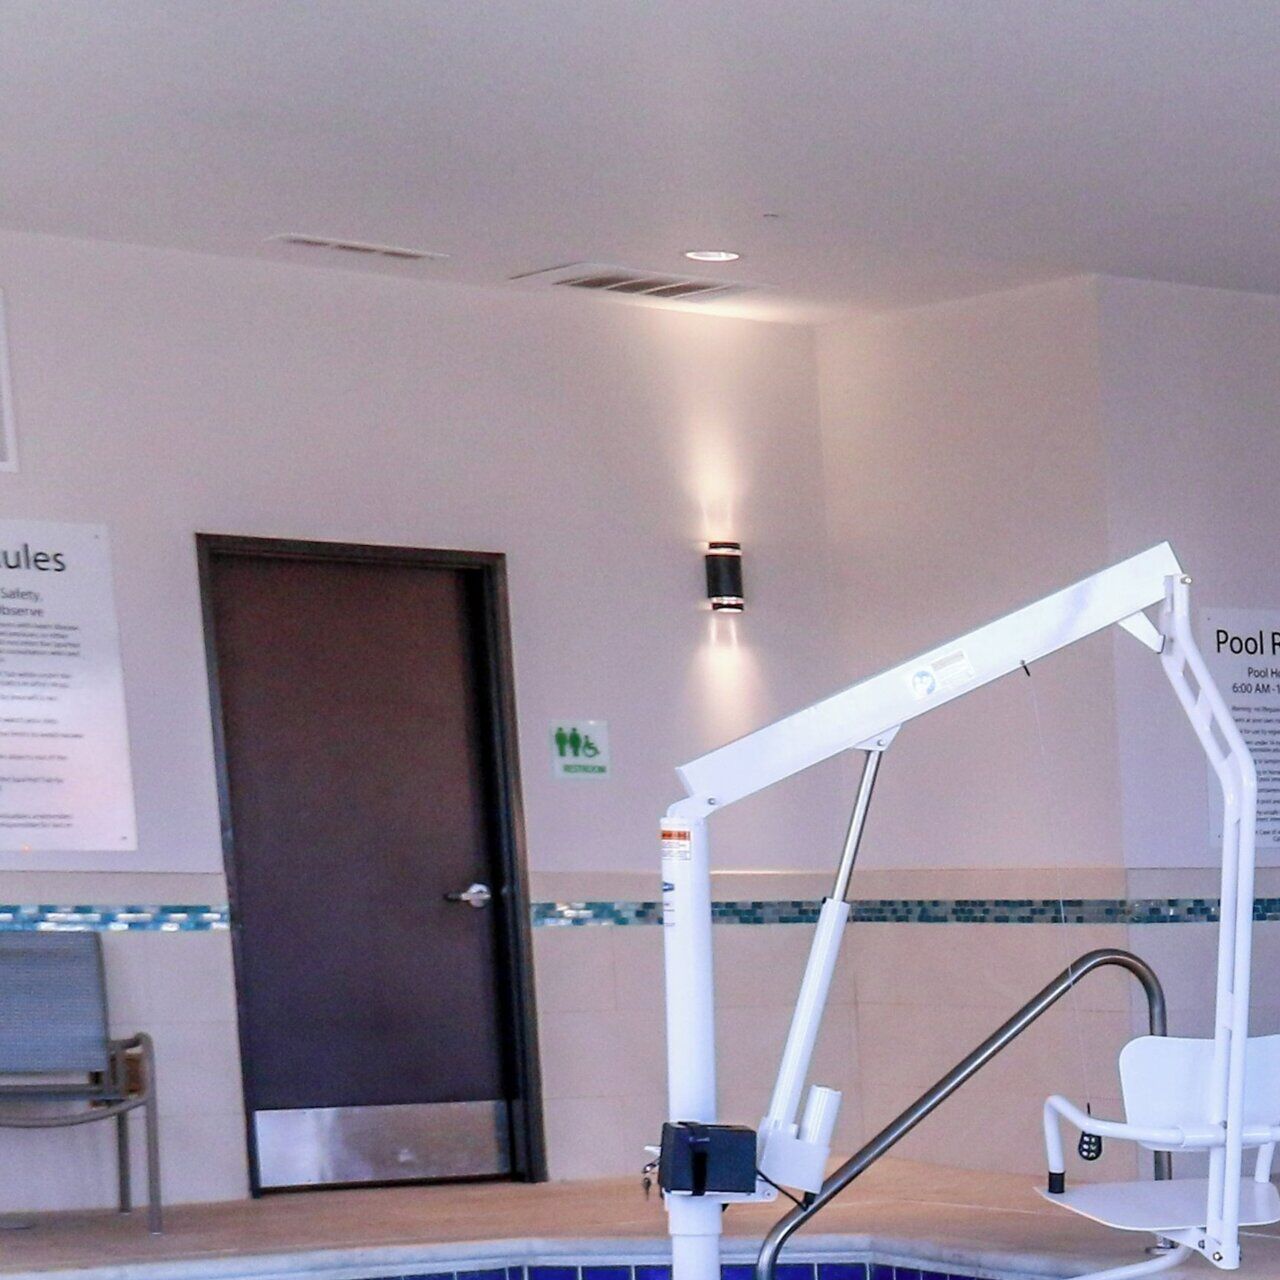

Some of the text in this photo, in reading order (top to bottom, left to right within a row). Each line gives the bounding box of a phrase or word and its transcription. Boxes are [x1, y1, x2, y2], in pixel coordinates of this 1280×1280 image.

[0, 543, 66, 571] ules
[0, 606, 44, 617] bserve
[1216, 629, 1264, 655] Pool
[1248, 667, 1269, 679] Pool
[1232, 683, 1252, 694] 6:00
[1254, 683, 1270, 694] AM
